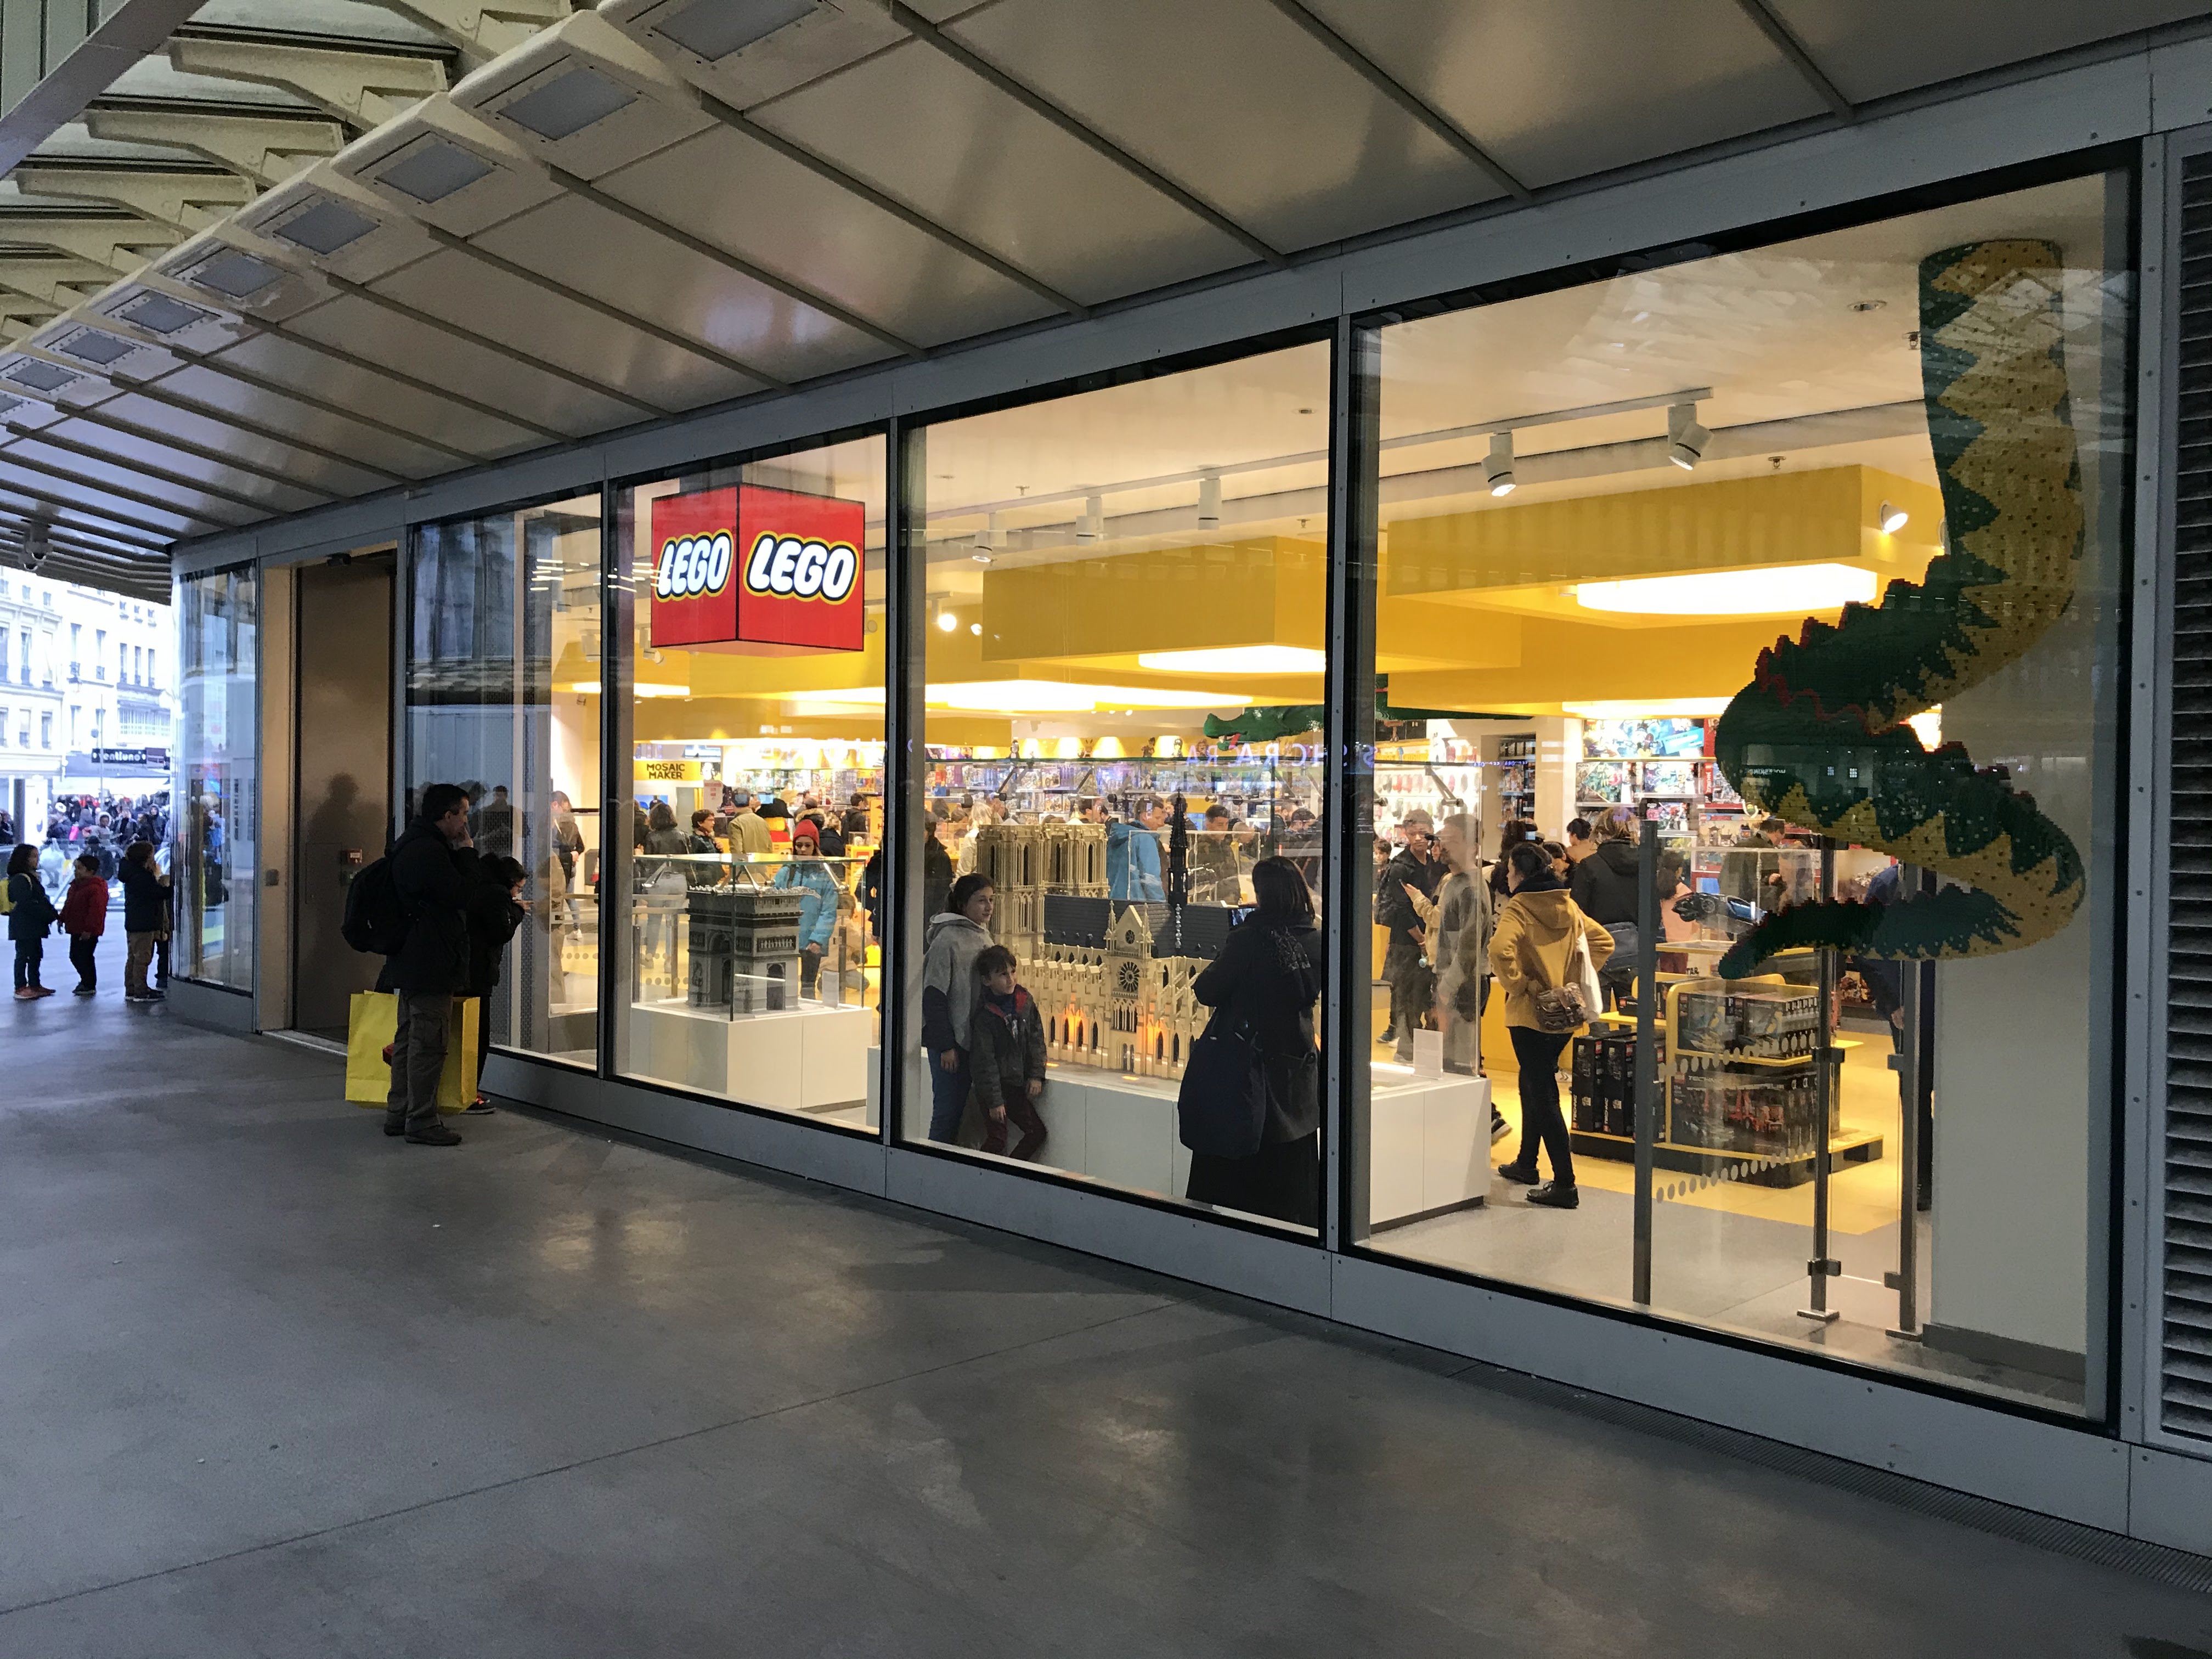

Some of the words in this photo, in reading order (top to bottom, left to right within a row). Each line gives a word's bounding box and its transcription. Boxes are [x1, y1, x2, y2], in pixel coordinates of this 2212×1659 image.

[658, 531, 732, 598] LEGO
[747, 535, 857, 601] LEGO
[646, 763, 685, 771] MOSAIC
[648, 771, 683, 780] MAKER
[1686, 967, 1700, 975] TAR
